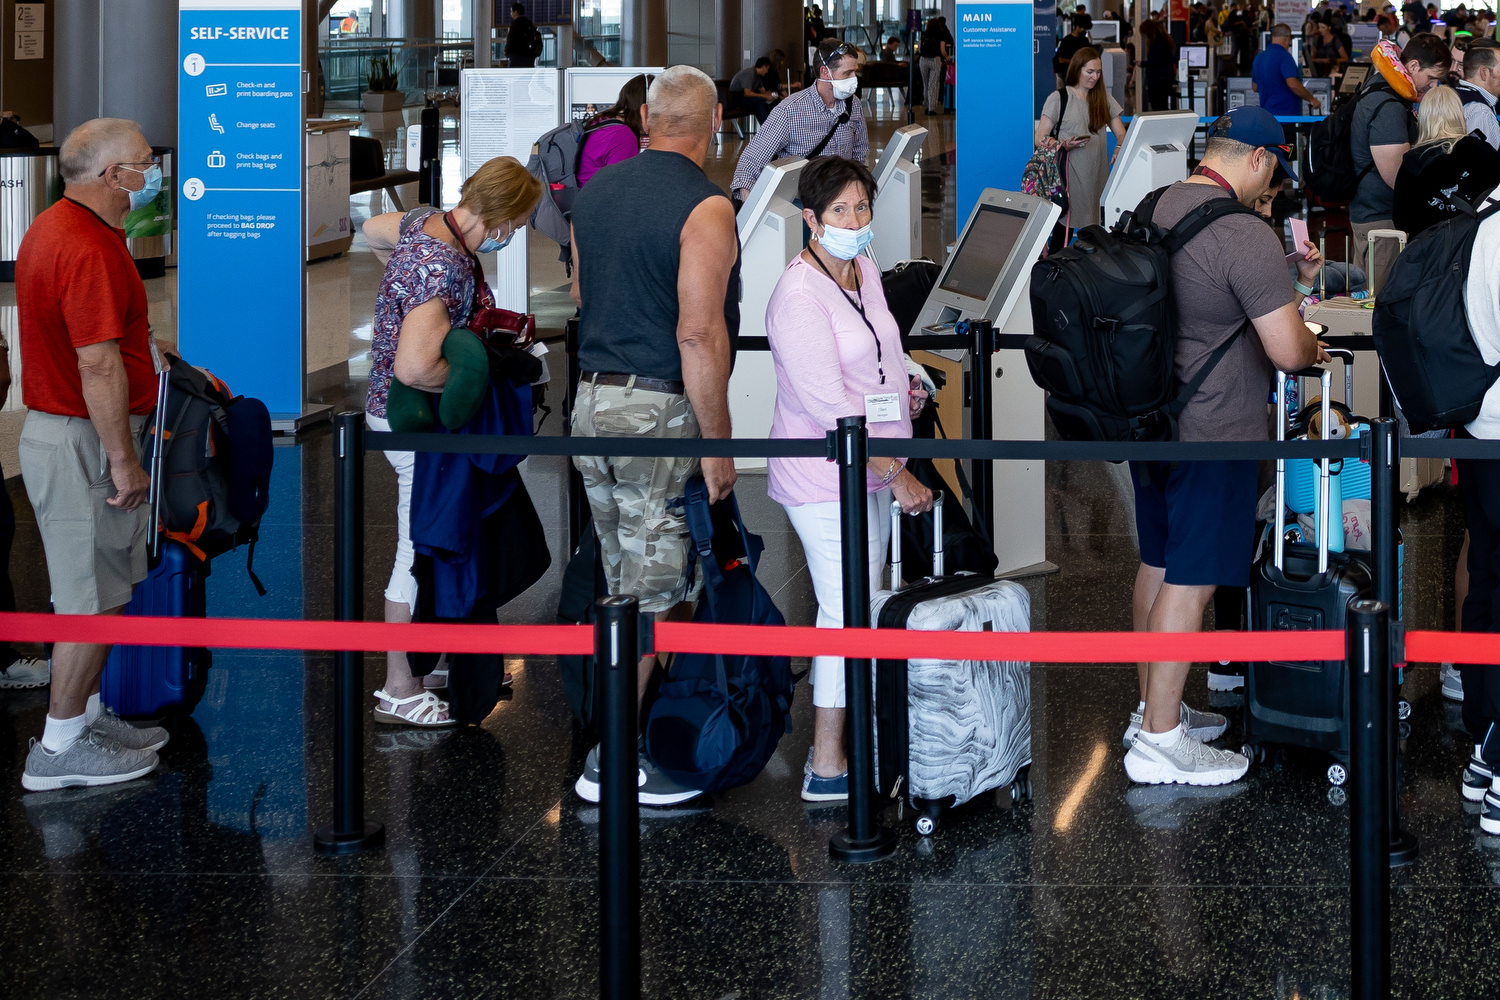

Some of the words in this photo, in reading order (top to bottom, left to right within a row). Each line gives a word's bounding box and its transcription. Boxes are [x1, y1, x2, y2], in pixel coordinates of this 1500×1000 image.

[18, 7, 24, 20] 2
[963, 13, 992, 22] MAIN
[190, 27, 289, 40] SELF-SERVICE
[19, 35, 22, 48] 1
[192, 62, 196, 72] 1
[236, 91, 251, 99] print
[252, 91, 279, 99] boarding
[236, 121, 259, 130] Change
[256, 153, 270, 161] bags
[236, 162, 251, 170] print
[252, 162, 264, 170] bag
[265, 162, 277, 170] tags
[0, 180, 24, 188] ASH
[191, 187, 197, 196] 2
[212, 214, 239, 222] checking
[256, 214, 276, 222] please
[224, 231, 246, 239] tagging
[247, 231, 261, 239] bags
